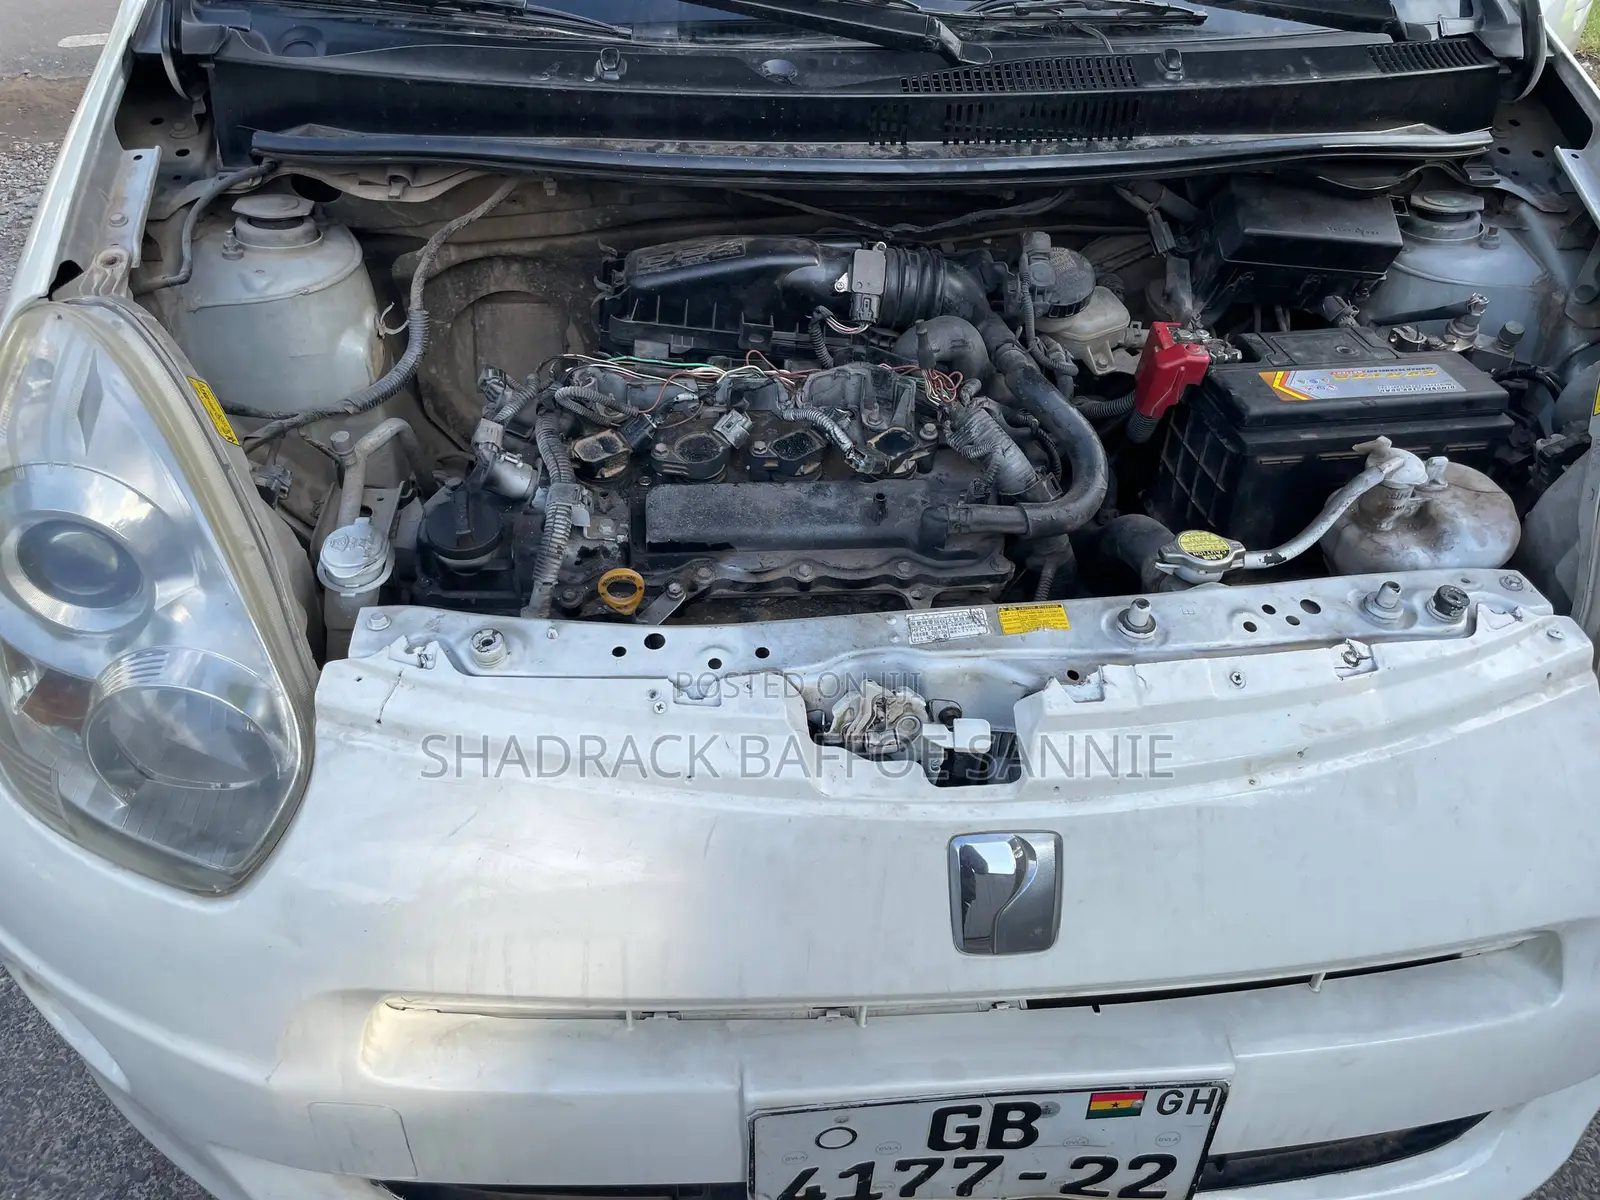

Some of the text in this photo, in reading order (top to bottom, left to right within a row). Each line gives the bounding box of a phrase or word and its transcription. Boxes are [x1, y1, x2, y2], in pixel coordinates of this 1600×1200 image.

[1156, 1088, 1218, 1116] GH
[927, 1101, 1042, 1151] GB
[777, 1153, 1178, 1200] 4177-22
